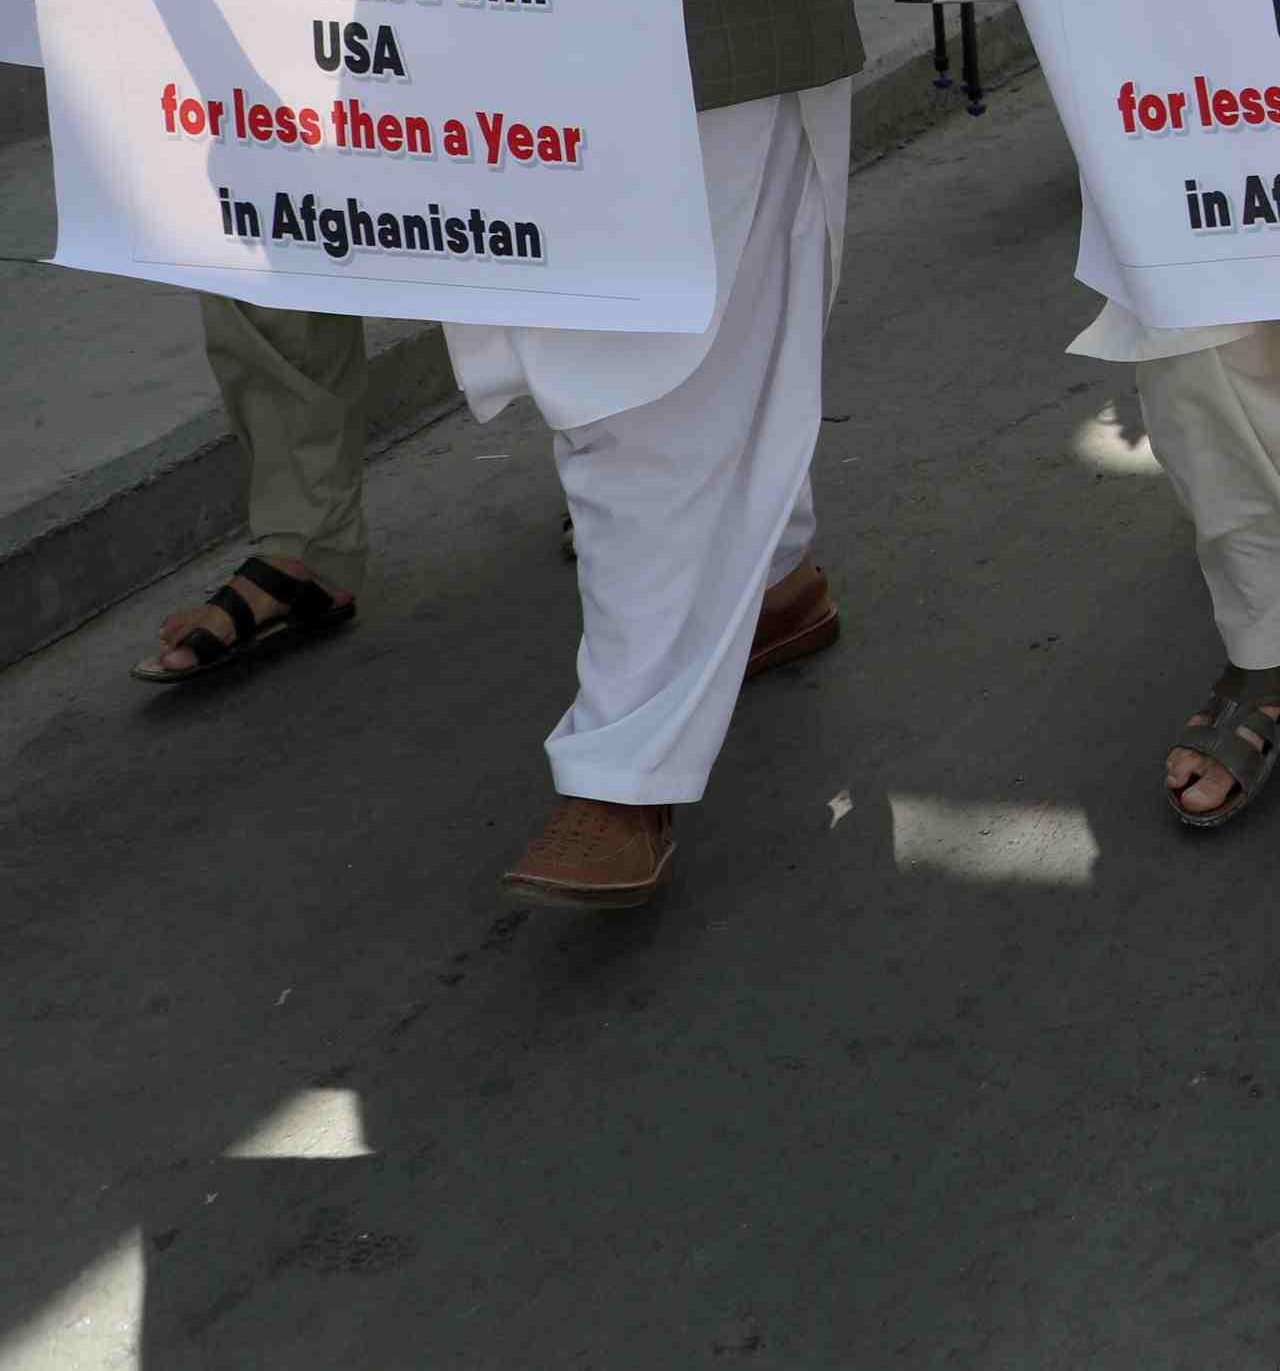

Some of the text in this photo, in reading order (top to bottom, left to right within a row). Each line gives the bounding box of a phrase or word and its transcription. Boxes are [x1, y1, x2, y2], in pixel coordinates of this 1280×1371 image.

[314, 21, 405, 76] USA
[161, 85, 580, 163] for less then a Year
[1120, 85, 1184, 132] for
[219, 187, 541, 258] in Afghanistan
[1185, 180, 1231, 229] in
